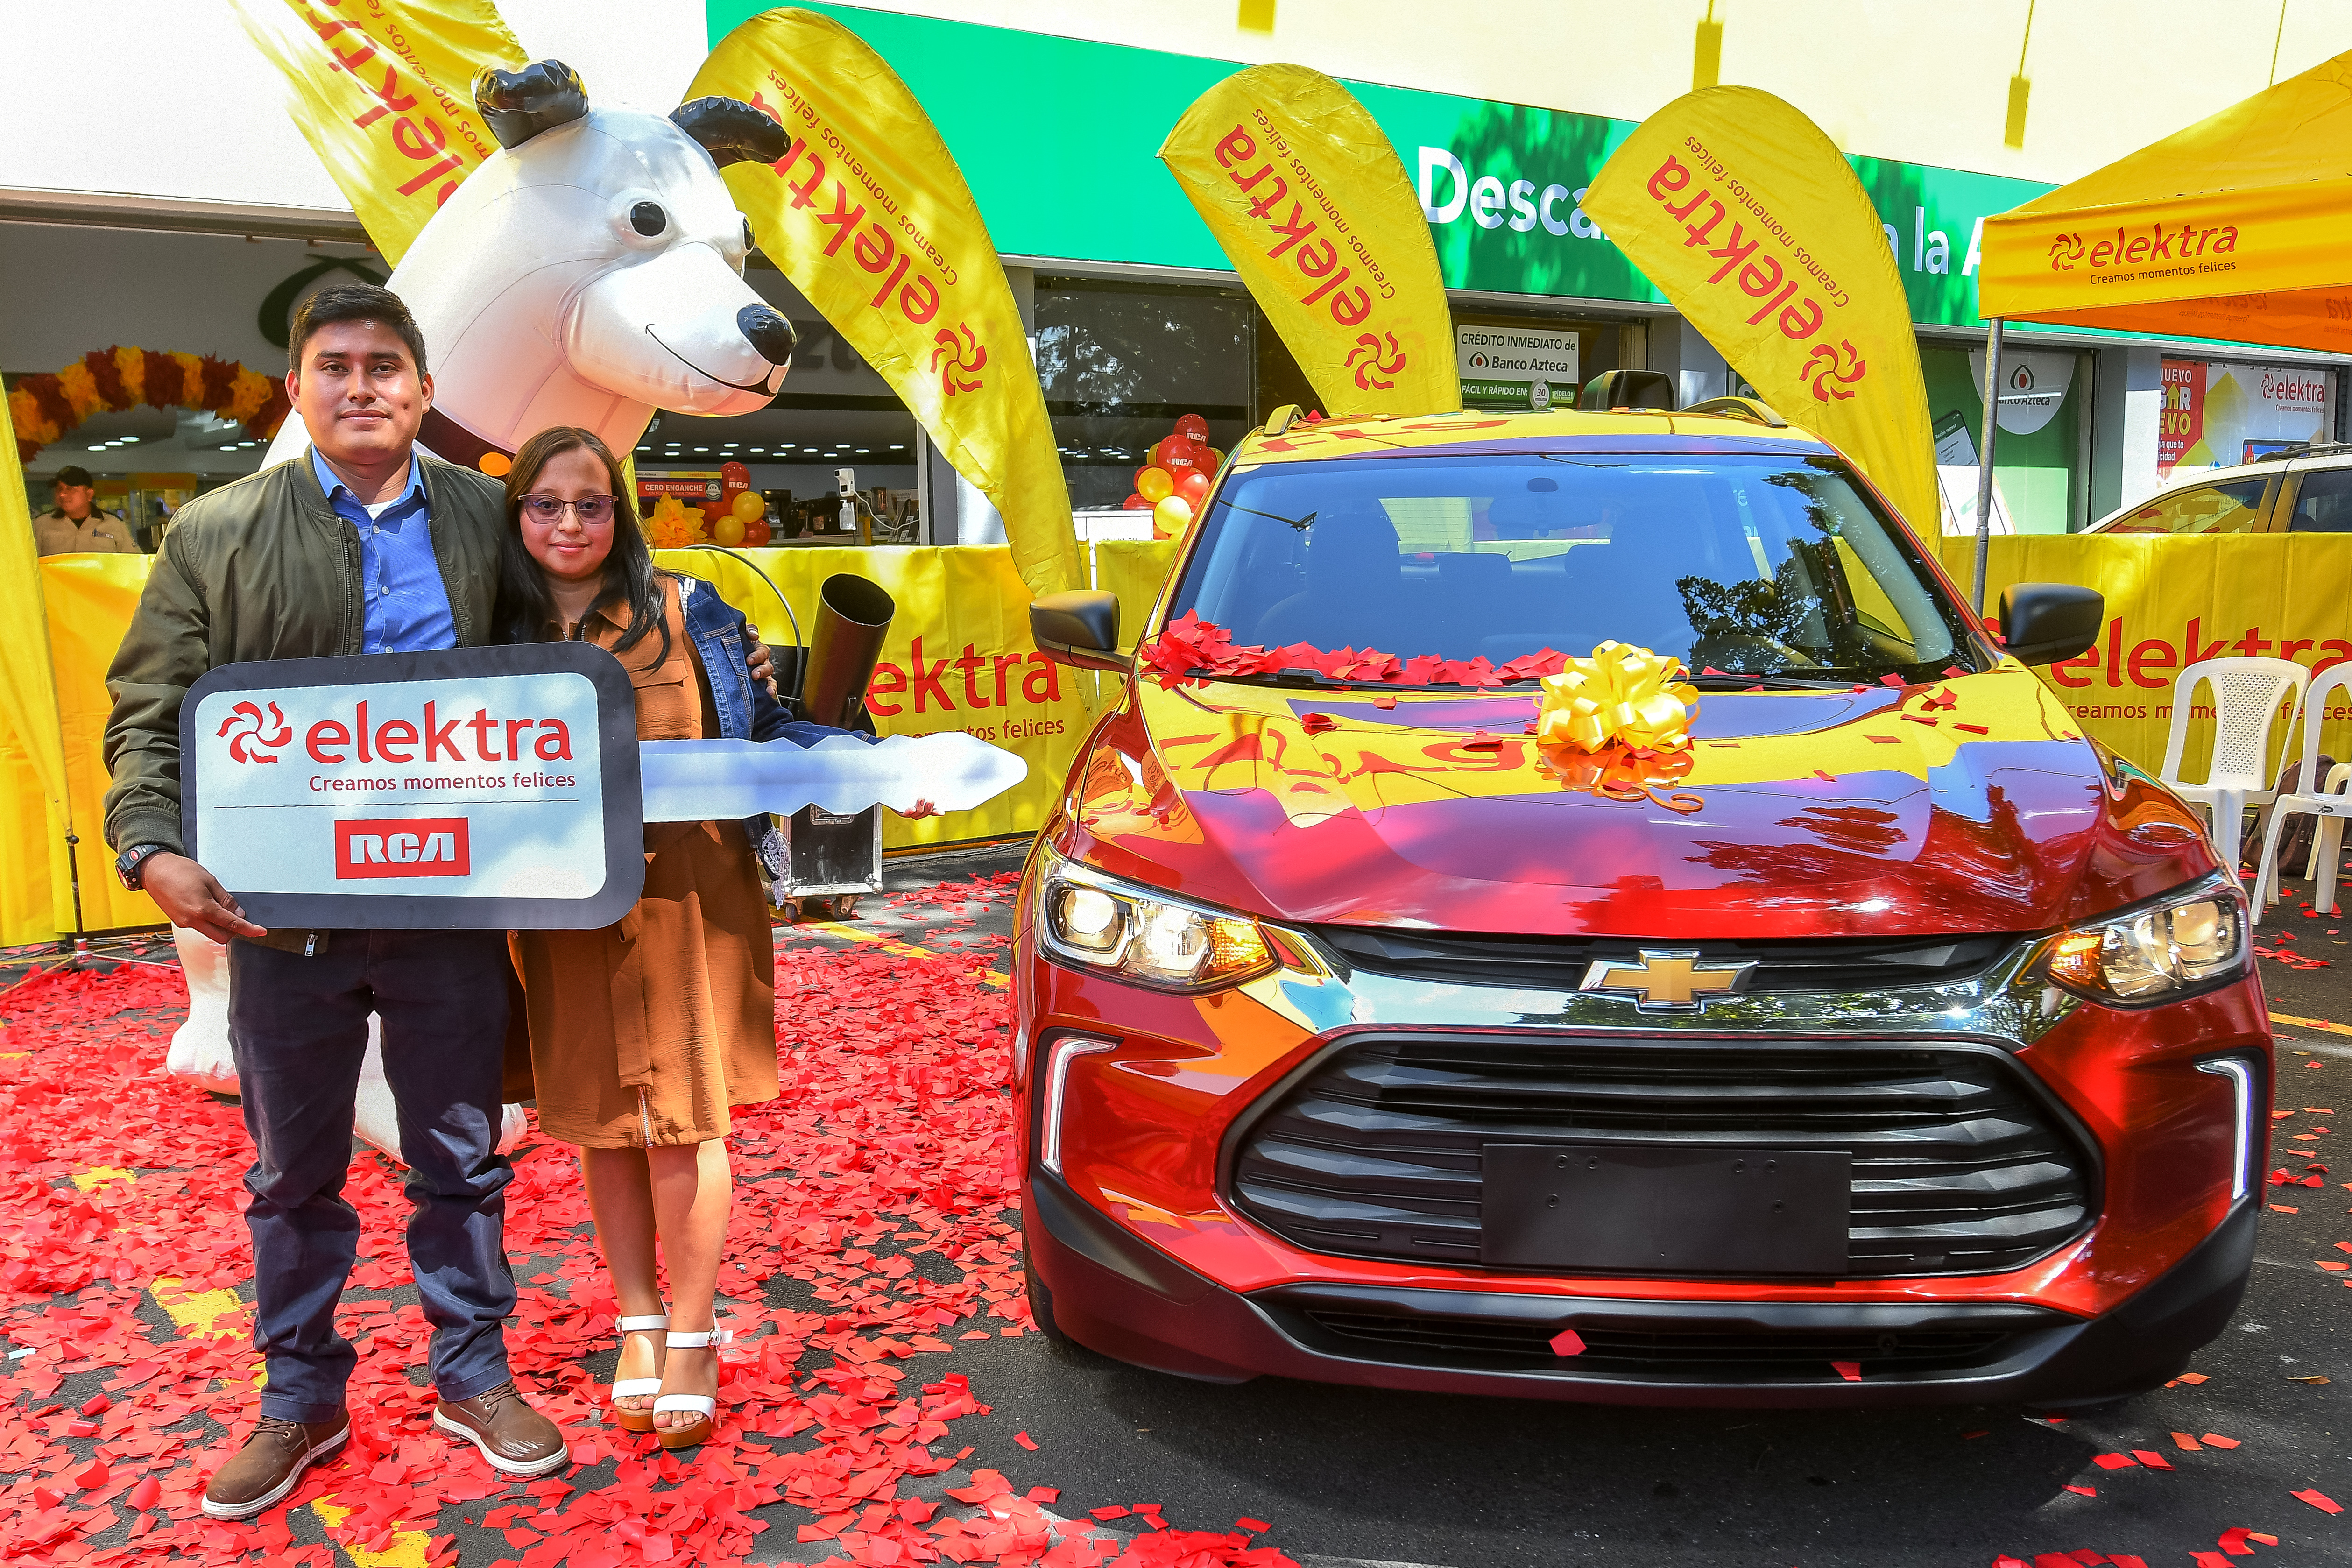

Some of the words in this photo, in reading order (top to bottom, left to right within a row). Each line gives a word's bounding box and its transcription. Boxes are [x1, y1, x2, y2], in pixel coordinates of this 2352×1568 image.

[297, 0, 463, 209] lektr
[767, 69, 821, 129] felices
[1252, 109, 1293, 158] felices
[821, 128, 899, 215] momentos
[1684, 136, 1729, 182] felices
[750, 91, 939, 324] elektr
[1291, 159, 1350, 234] momentos
[1419, 146, 1611, 240] Desca
[1914, 205, 1949, 275] la
[1727, 179, 1795, 248] momentos
[1215, 124, 1371, 326] elektra
[1647, 155, 1823, 339] elektra
[2090, 223, 2238, 267] elektra
[898, 215, 957, 285] Creamos
[1347, 235, 1395, 300] Creamos
[2091, 273, 2135, 284] Creamos
[2139, 266, 2195, 280] momentos
[2199, 261, 2236, 273] felices
[1793, 247, 1849, 307] Creamos
[1461, 331, 1504, 346] CRÉDITO
[1507, 336, 1562, 350] INMEDIATO
[1564, 339, 1576, 351] de
[1491, 356, 1527, 370] Banco
[1529, 358, 1568, 372] Azteca
[1462, 383, 1481, 394] FÁCIL
[1483, 386, 1488, 394] Y
[1489, 384, 1515, 396] RÁPIDO
[1999, 395, 2020, 405] anco
[2276, 374, 2324, 402] elektra
[1186, 432, 1206, 442] RCA
[2166, 441, 2177, 451] que
[2178, 440, 2184, 449] te
[1171, 457, 1193, 466] RCA
[864, 635, 1062, 717] ektra
[306, 699, 573, 763] elektra
[1003, 718, 1065, 739] felices
[2066, 703, 2147, 720] reamos
[309, 775, 397, 792] Creamos
[403, 773, 506, 790] momentos
[512, 772, 576, 788] felices
[349, 832, 455, 864] RCA
